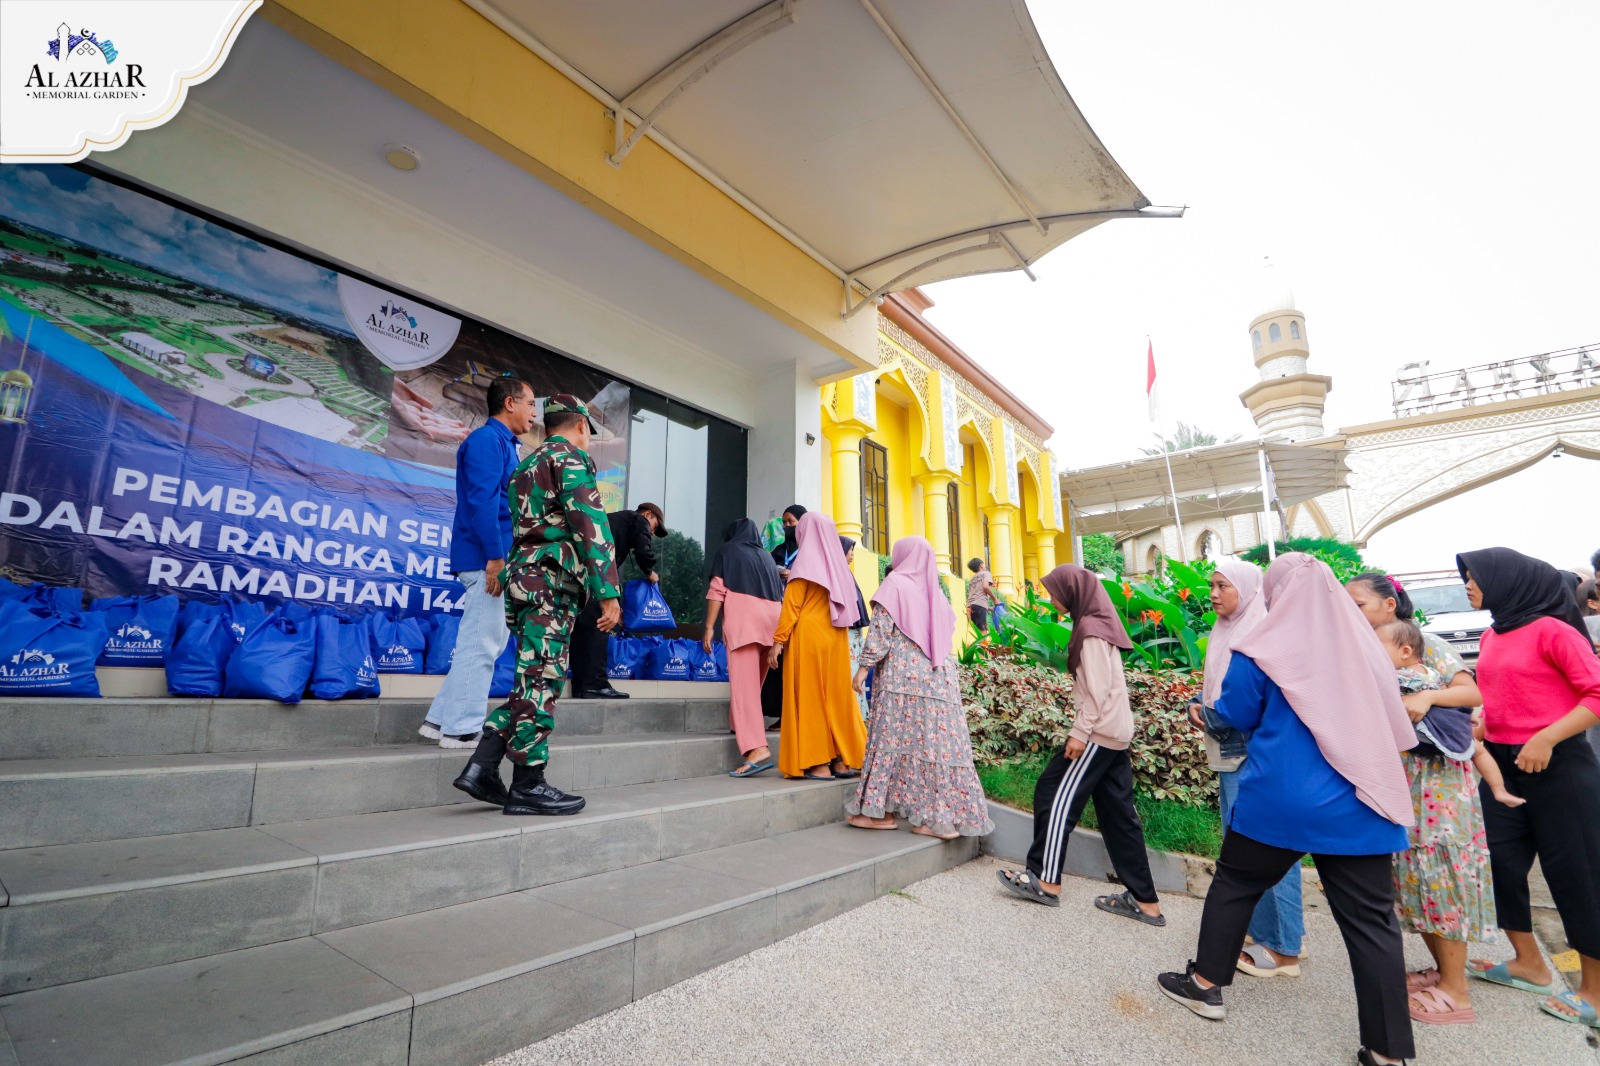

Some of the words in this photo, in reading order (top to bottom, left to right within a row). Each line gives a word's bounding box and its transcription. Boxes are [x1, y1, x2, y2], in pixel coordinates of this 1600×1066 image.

[366, 313, 385, 329] AL
[387, 324, 430, 346] AZHAR
[369, 326, 401, 341] MEMORIAL
[402, 338, 426, 350] GARDEN
[112, 467, 388, 539] PEMBAGIAN
[0, 491, 203, 549] DALAM
[217, 524, 395, 573] RANGKA
[405, 552, 462, 582] ME
[147, 556, 410, 609] RAMADHAN
[105, 637, 122, 648] AL
[123, 639, 163, 649] AZHAR
[0, 664, 18, 677] AL
[20, 663, 70, 677] AZHAR
